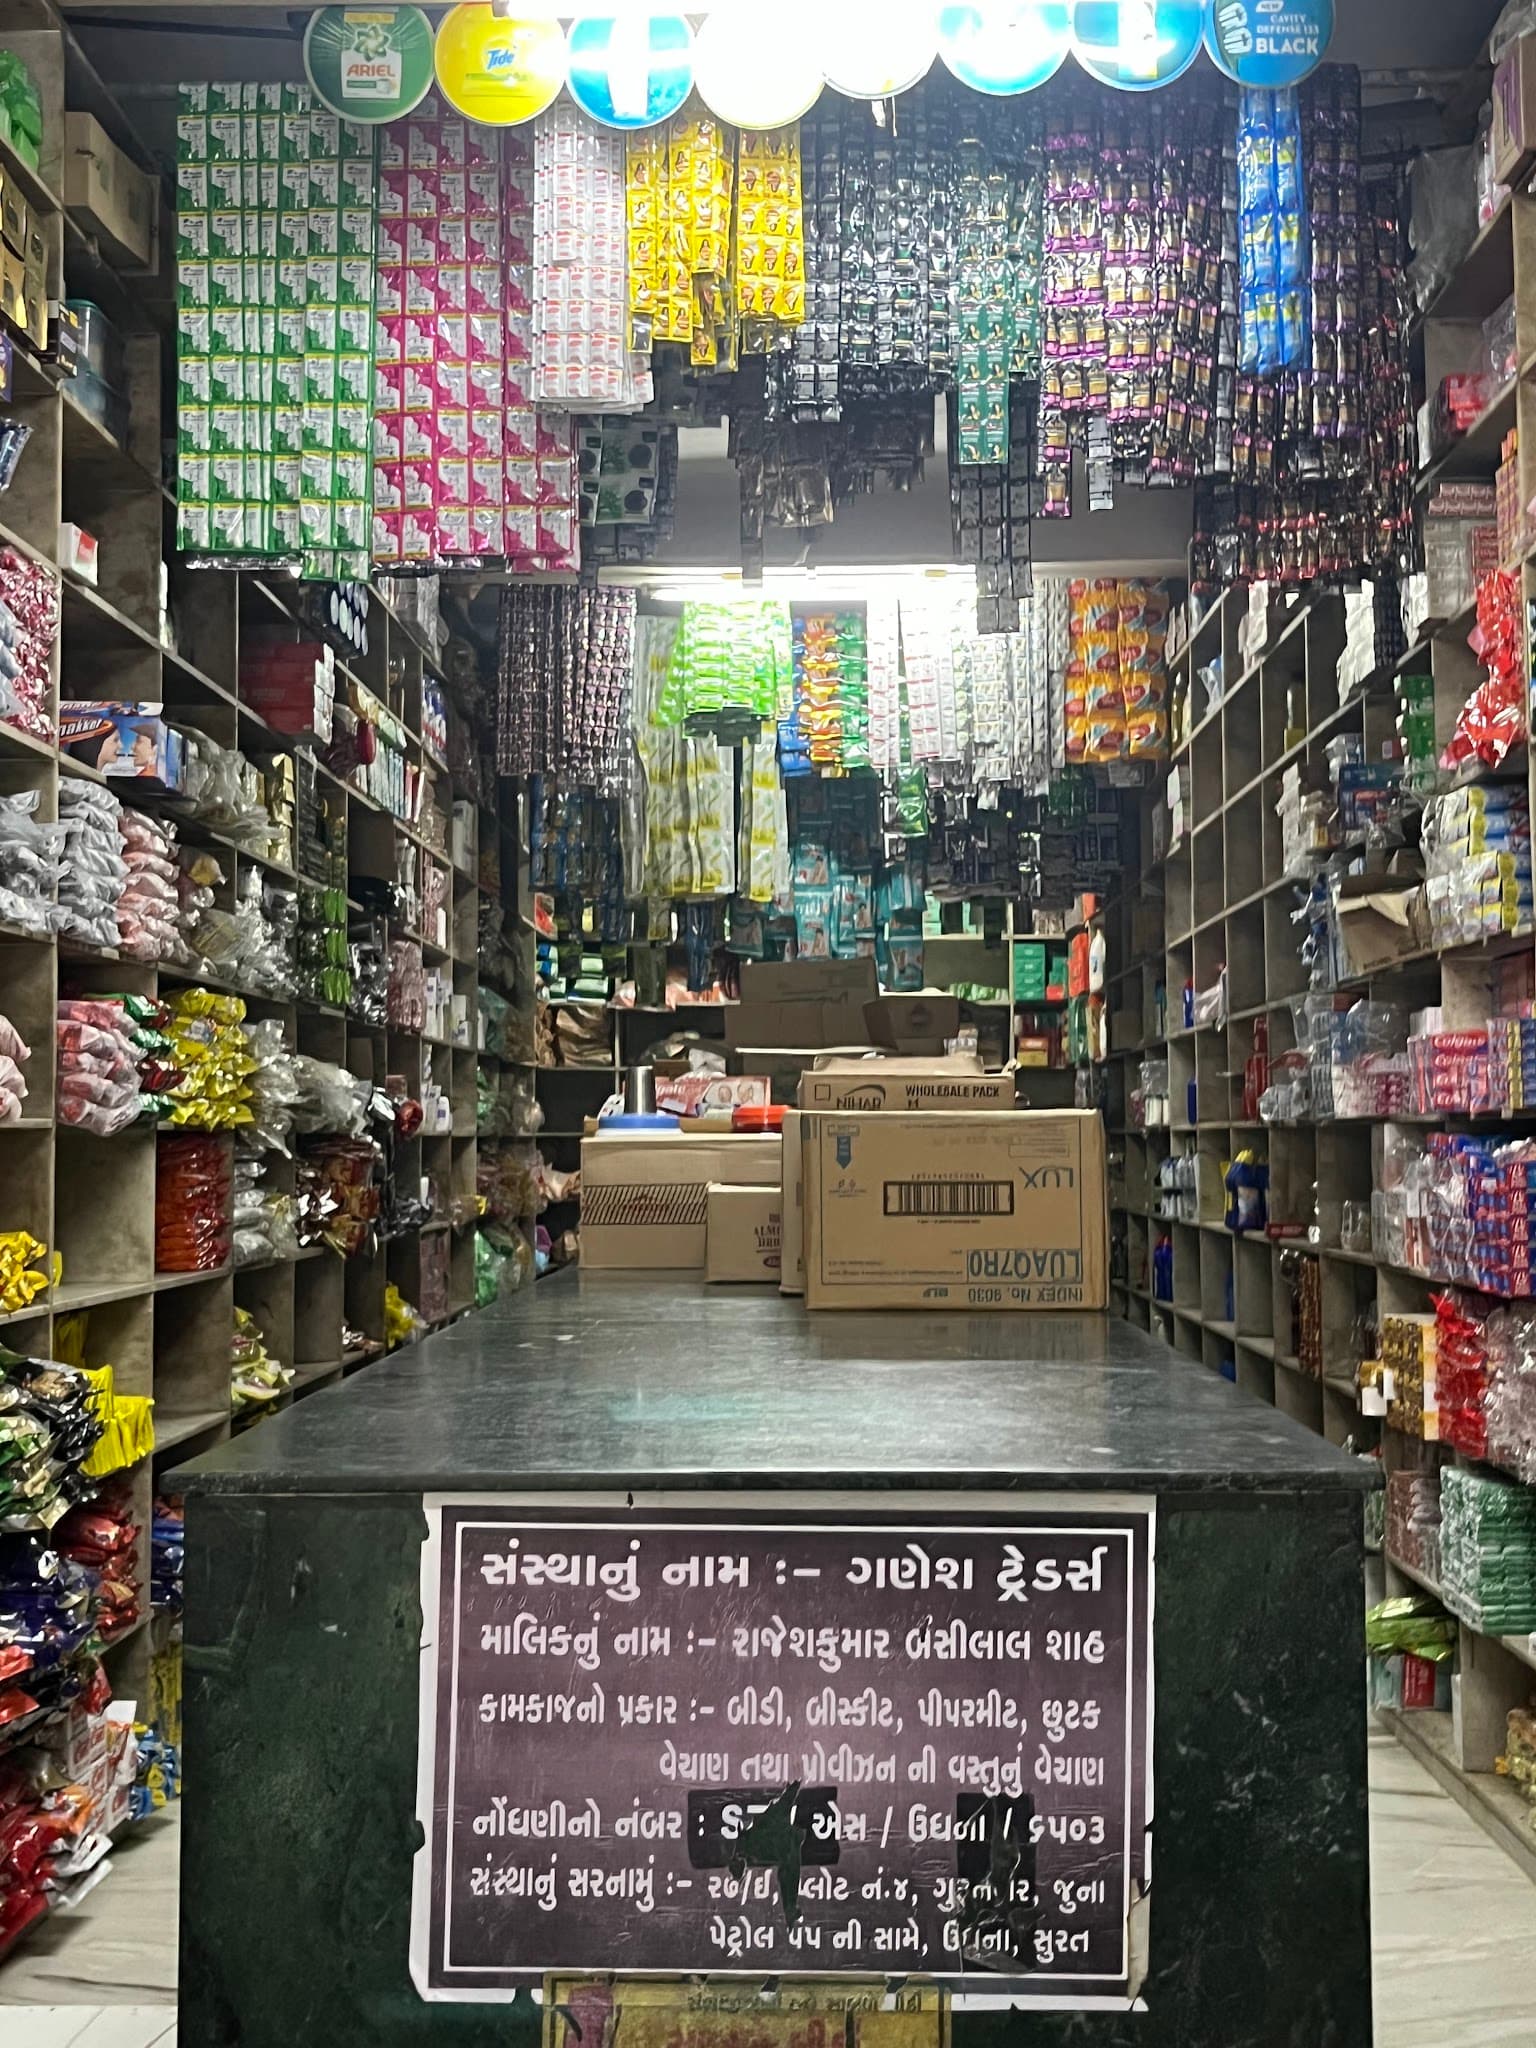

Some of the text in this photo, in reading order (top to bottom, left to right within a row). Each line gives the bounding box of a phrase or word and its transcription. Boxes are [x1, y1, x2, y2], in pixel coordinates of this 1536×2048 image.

[487, 48, 515, 70] Tide
[1255, 37, 1319, 56] BLACK
[347, 64, 396, 77] ARIEL
[905, 1084, 1001, 1097] WHOLESALE PACK
[1018, 1166, 1074, 1190] LUX
[1037, 1287, 1083, 1303] INDEX
[480, 1537, 641, 1602] સંસ્થાનું
[662, 1556, 749, 1588] નામ
[845, 1543, 973, 1590] ગણેશ
[996, 1544, 1108, 1602] ટ્રેડર્સ
[480, 1611, 601, 1671] માલિકનું
[613, 1626, 671, 1657] નામ
[731, 1614, 890, 1674] રાજેશકુમાર
[1045, 1629, 1105, 1664] શાહ
[478, 1682, 605, 1724] કામકાજનો
[617, 1694, 677, 1727] પ્રકાર
[727, 1685, 792, 1734] બીડી,
[1042, 1699, 1101, 1743] છુટક
[659, 1739, 729, 1782] વેચાણ
[740, 1752, 789, 1783] તથા
[907, 1744, 936, 1784] ની
[1034, 1743, 1104, 1786] વેચાણ
[614, 1796, 682, 1840] નંબર
[811, 1801, 867, 1842] એસ
[567, 1854, 655, 1913] સરનામું
[1053, 1879, 1105, 1914] જુના
[709, 1915, 774, 1957] પેટ્રોલ
[832, 1918, 862, 1950] ની
[873, 1917, 928, 1957] સામે,
[1033, 1929, 1089, 1964] સુરત
